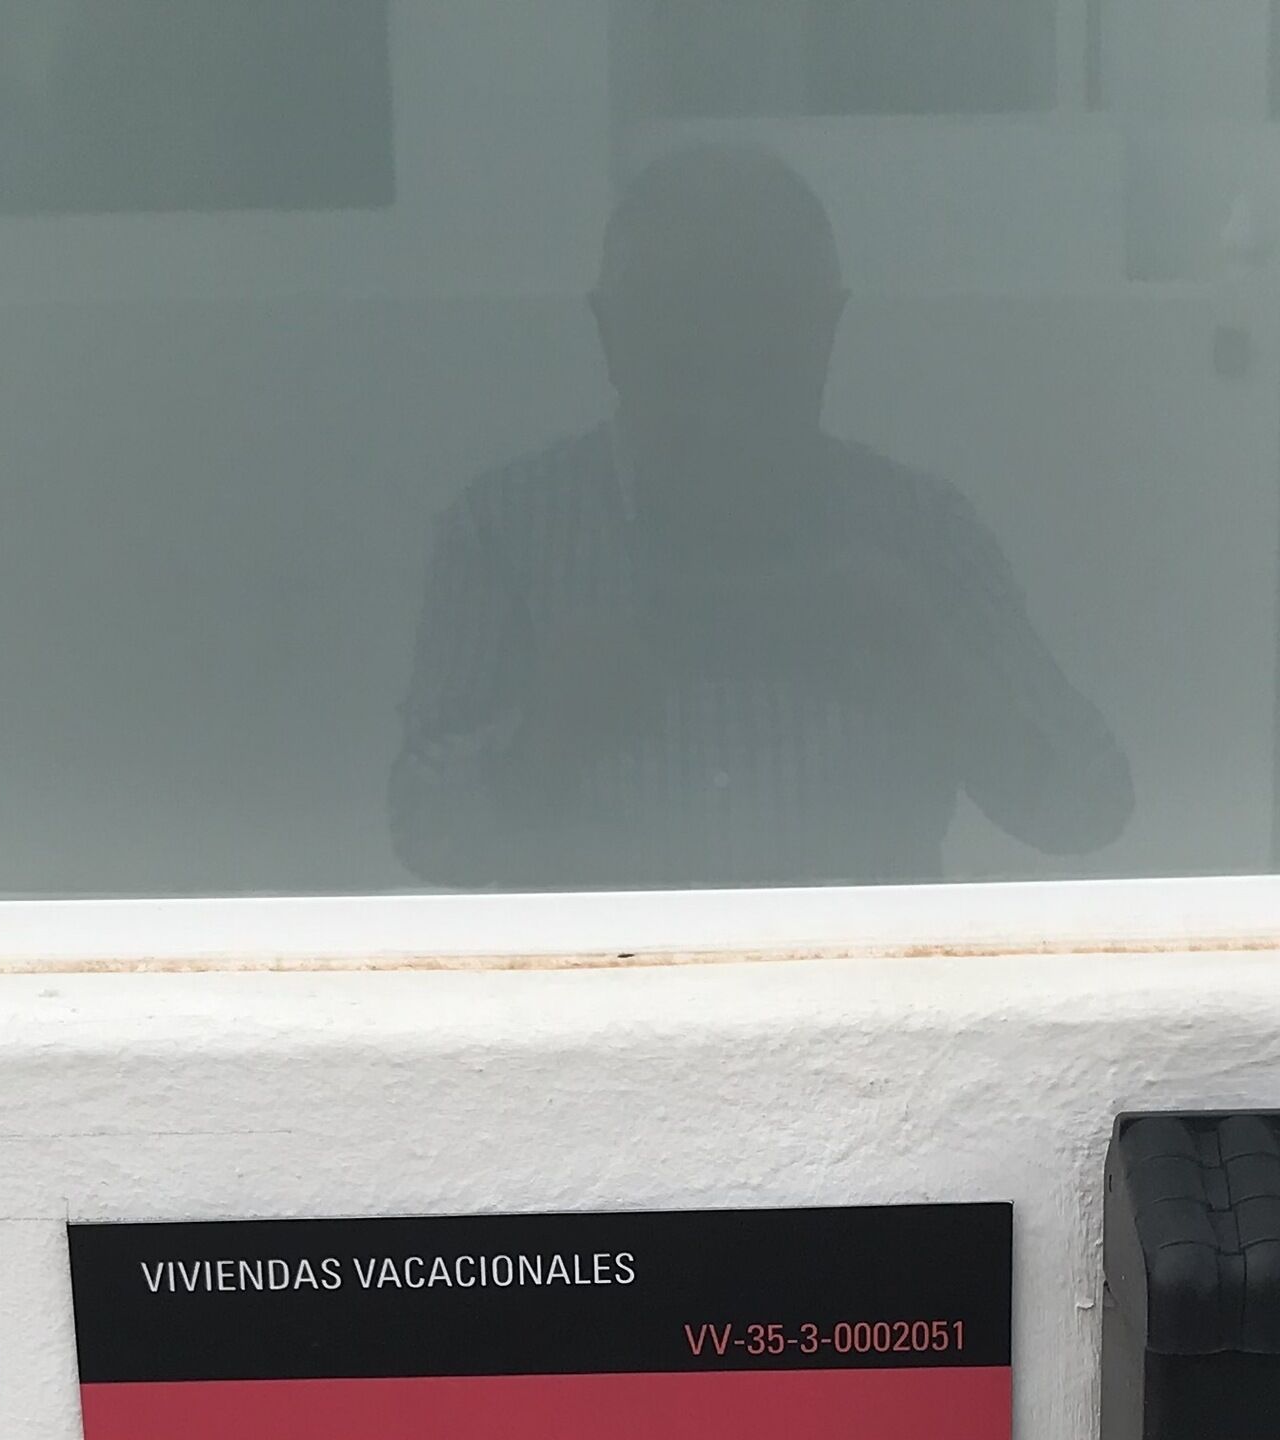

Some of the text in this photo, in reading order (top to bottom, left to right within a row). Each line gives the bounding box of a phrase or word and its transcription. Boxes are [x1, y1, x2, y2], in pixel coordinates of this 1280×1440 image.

[141, 1251, 637, 1294] VIVIENDAS VACACIONALES
[683, 1319, 968, 1358] VV-35-3-0002051
